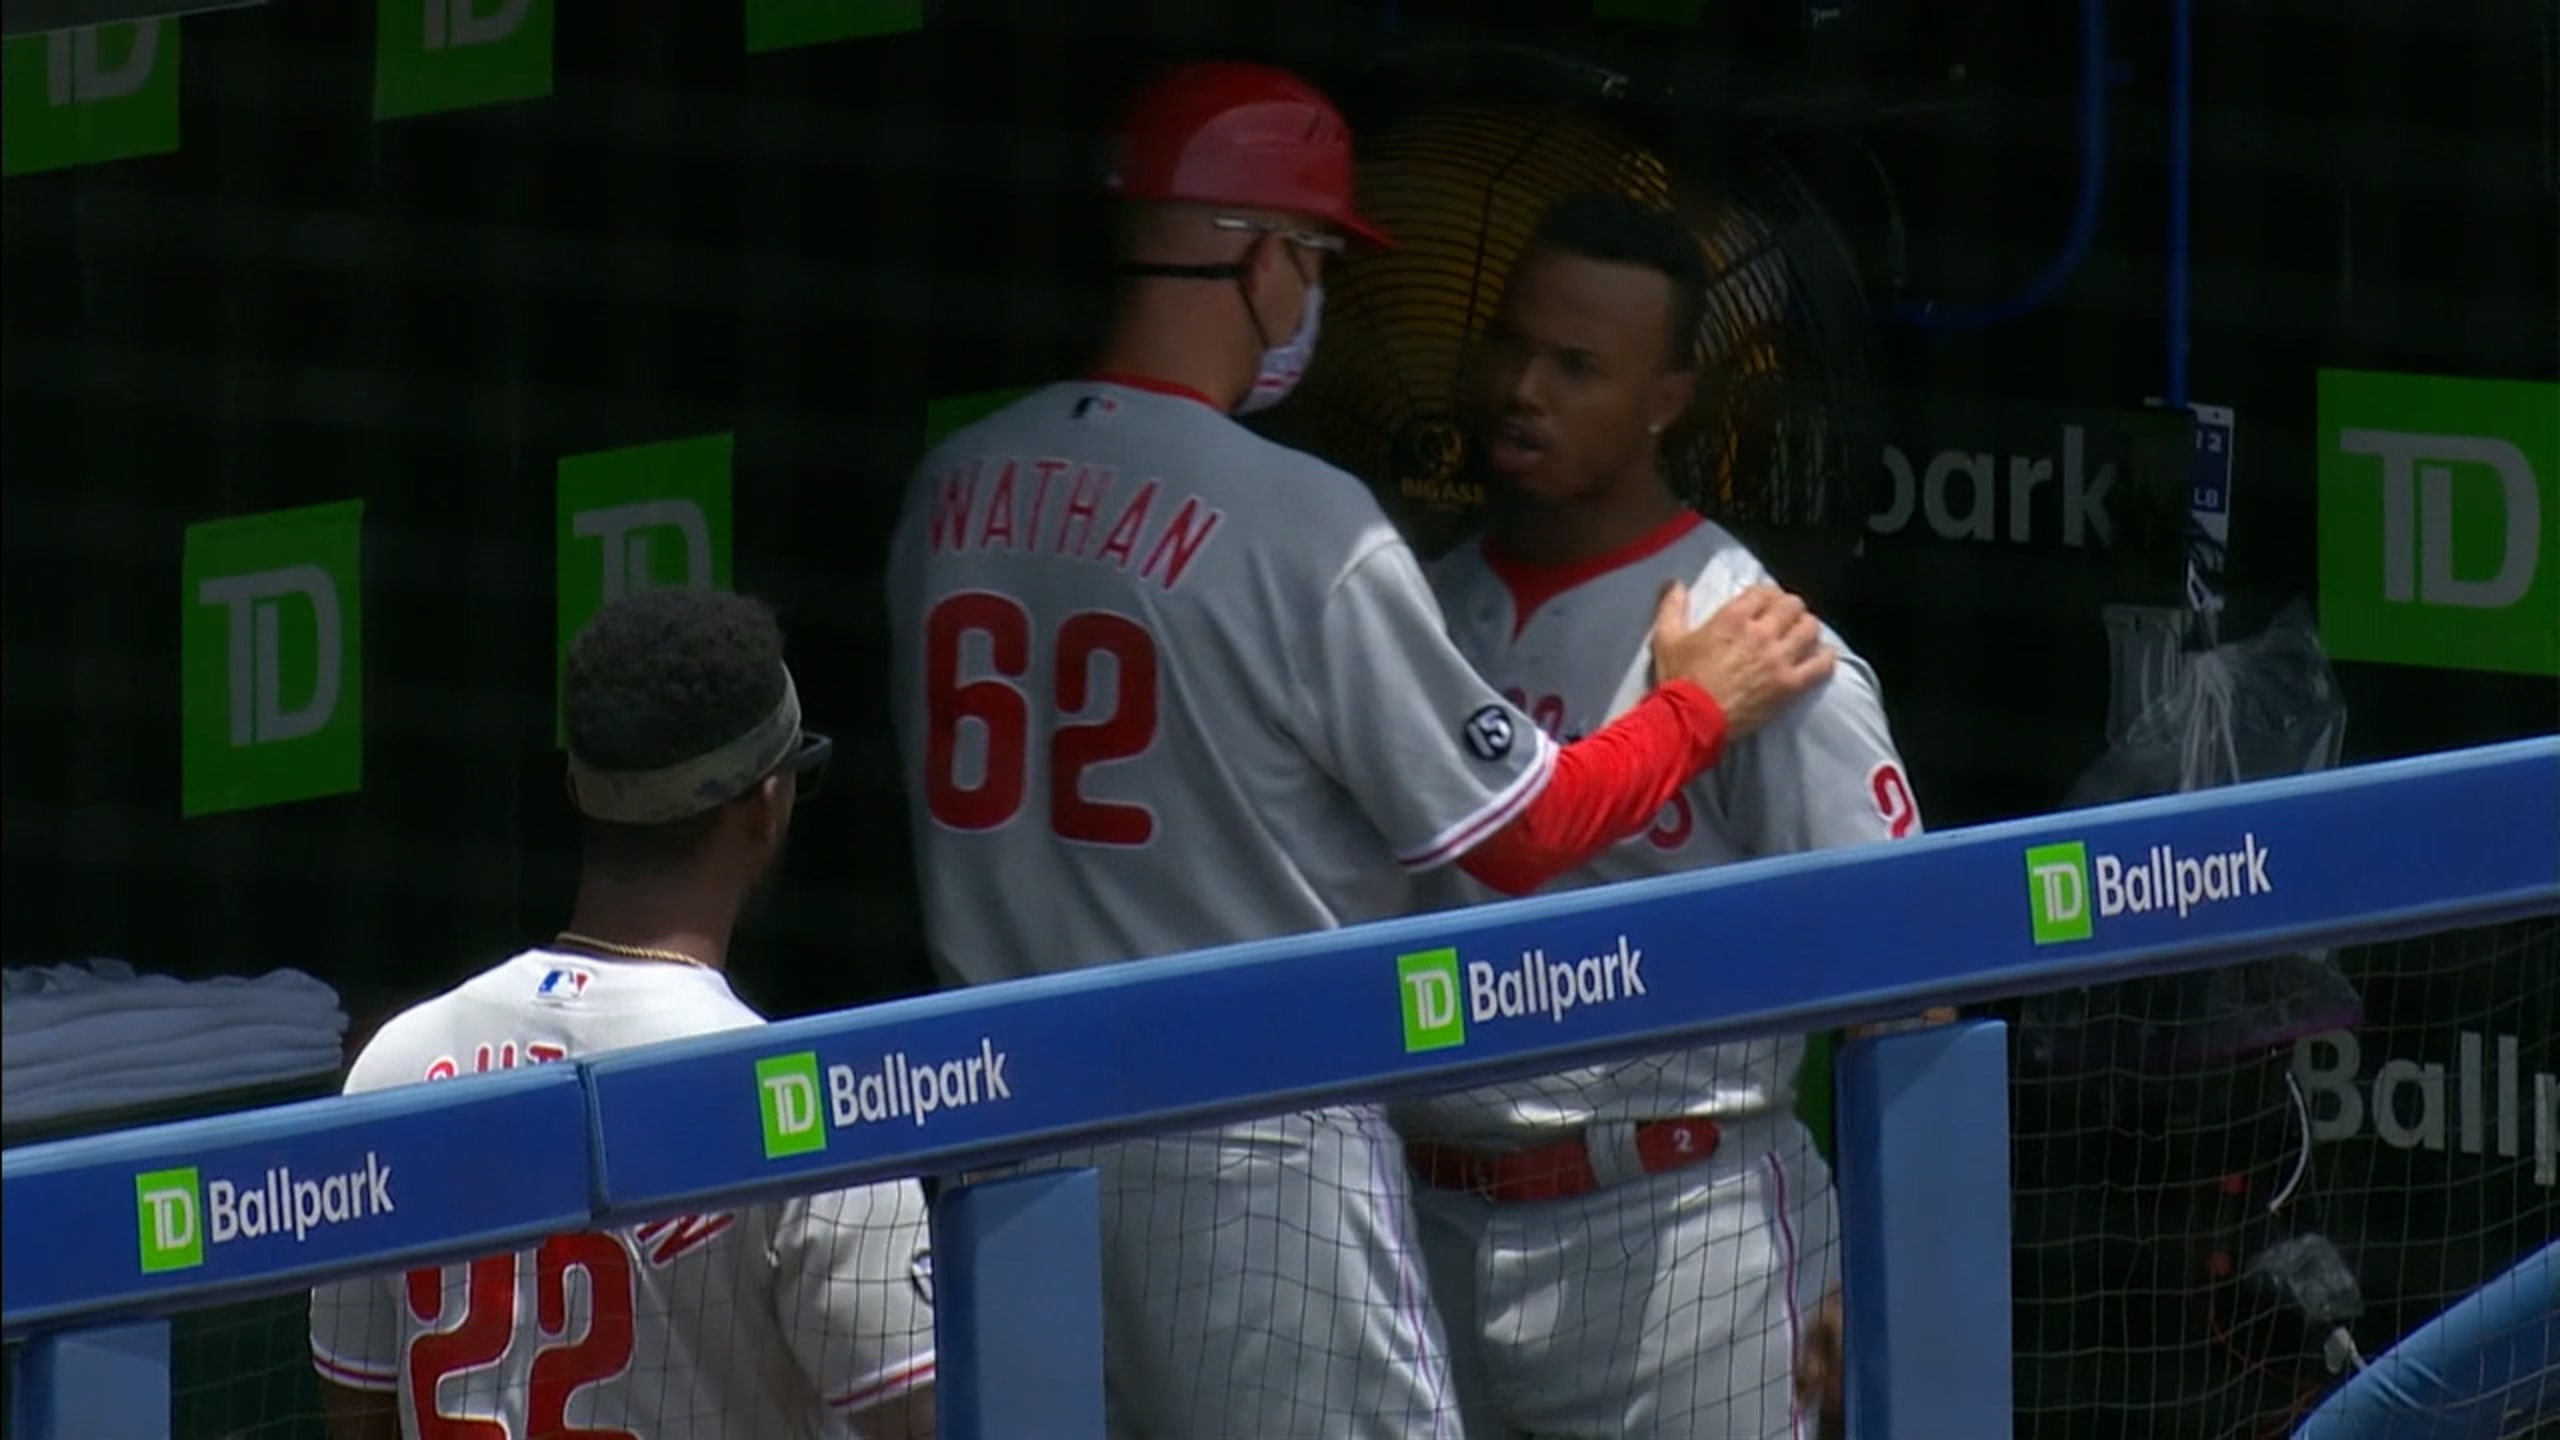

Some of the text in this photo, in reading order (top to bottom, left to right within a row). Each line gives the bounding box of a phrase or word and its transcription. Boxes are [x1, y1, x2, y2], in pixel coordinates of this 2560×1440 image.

[928, 460, 1224, 593] WATHAN
[2339, 428, 2542, 609] TD
[200, 562, 341, 747] TD
[925, 589, 1160, 848] 62
[1467, 707, 1511, 757] 15
[2033, 832, 2272, 924] TD Ballpark
[1405, 933, 1647, 1031] TD Ballpark
[764, 1036, 1012, 1137] TD Ballpark
[1671, 1126, 1697, 1153] 2
[143, 1150, 396, 1251] TD Ballpark
[405, 1226, 642, 1440] 22
